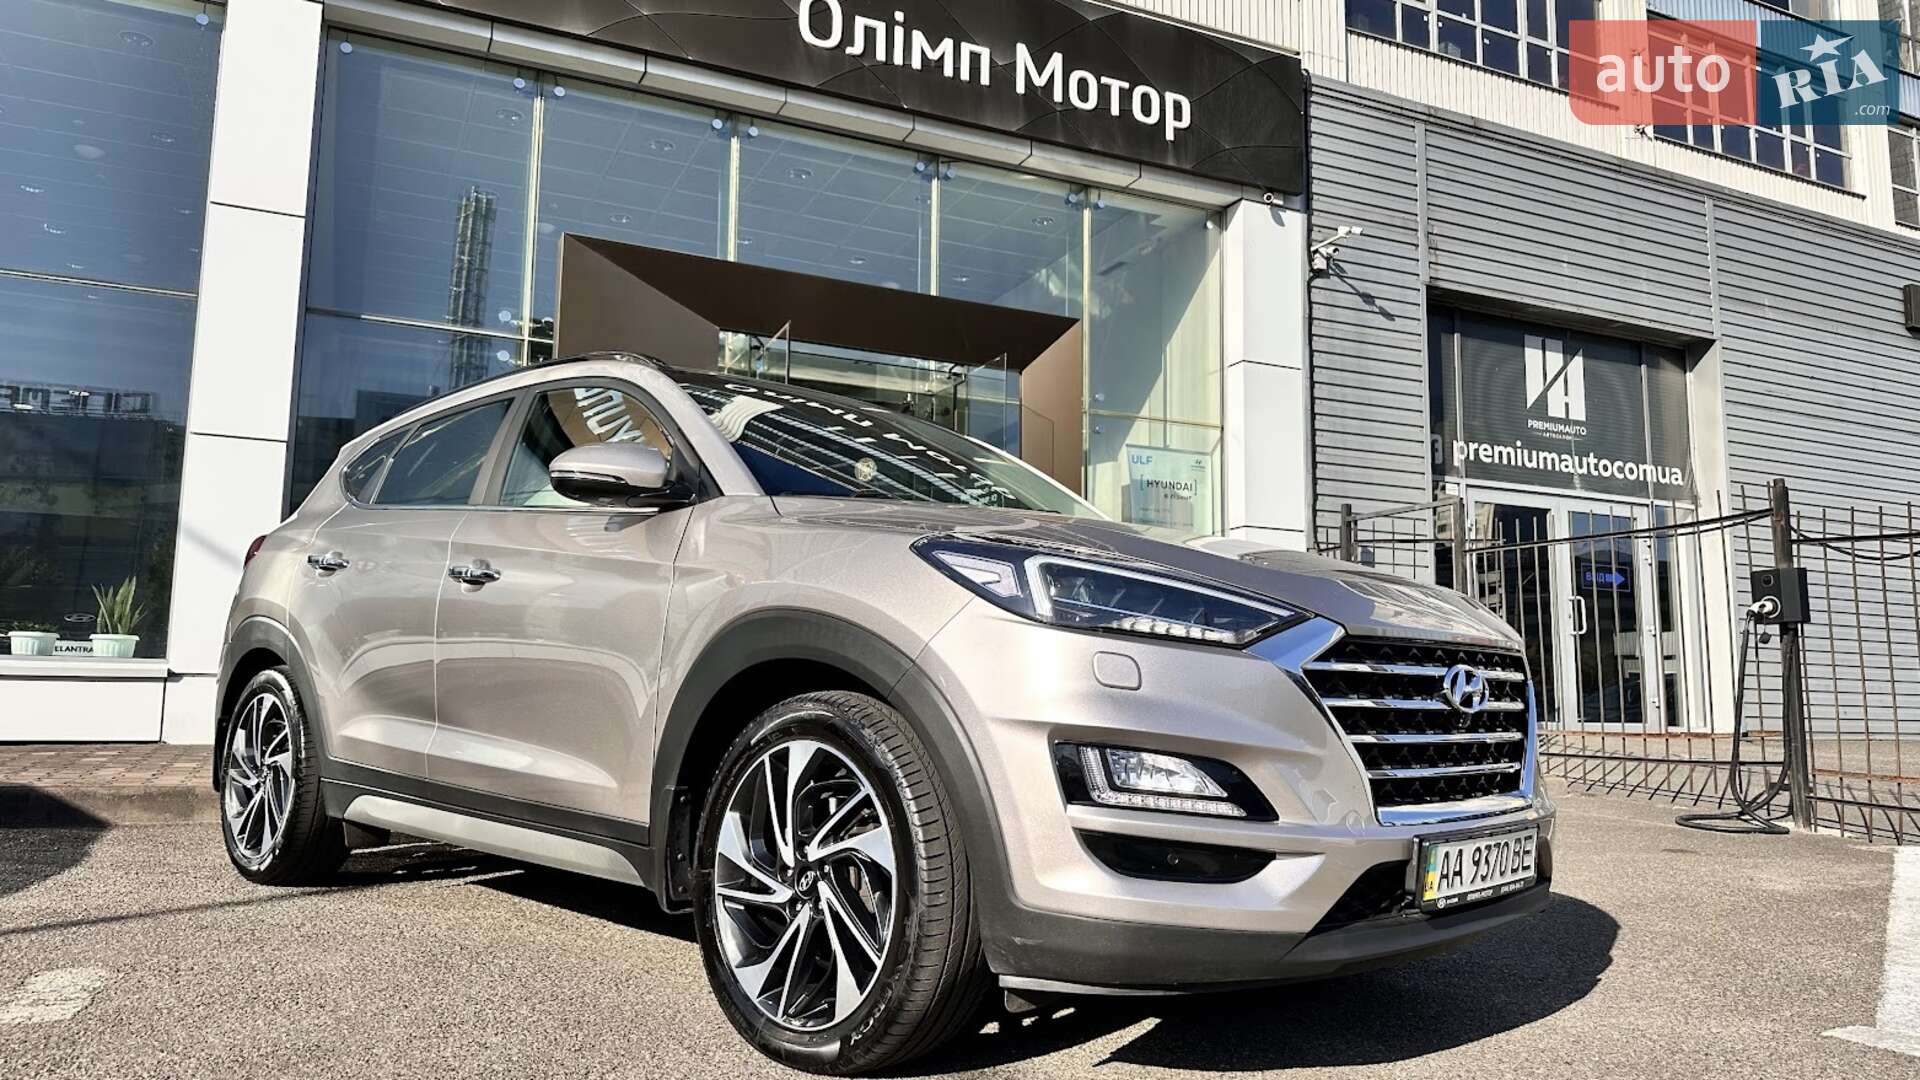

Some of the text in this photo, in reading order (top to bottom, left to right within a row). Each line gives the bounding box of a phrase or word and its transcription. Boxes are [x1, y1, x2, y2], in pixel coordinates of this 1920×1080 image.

[798, 0, 1192, 142] Олімп Мотор
[1527, 418, 1587, 436] PREMIUMAUTO
[1131, 455, 1153, 465] ULF
[1452, 439, 1685, 486] premiumautocomua
[1146, 479, 1193, 492] HYUNDAI
[54, 645, 95, 653] ELANTRA
[1437, 834, 1534, 892] AA 9370 BE
